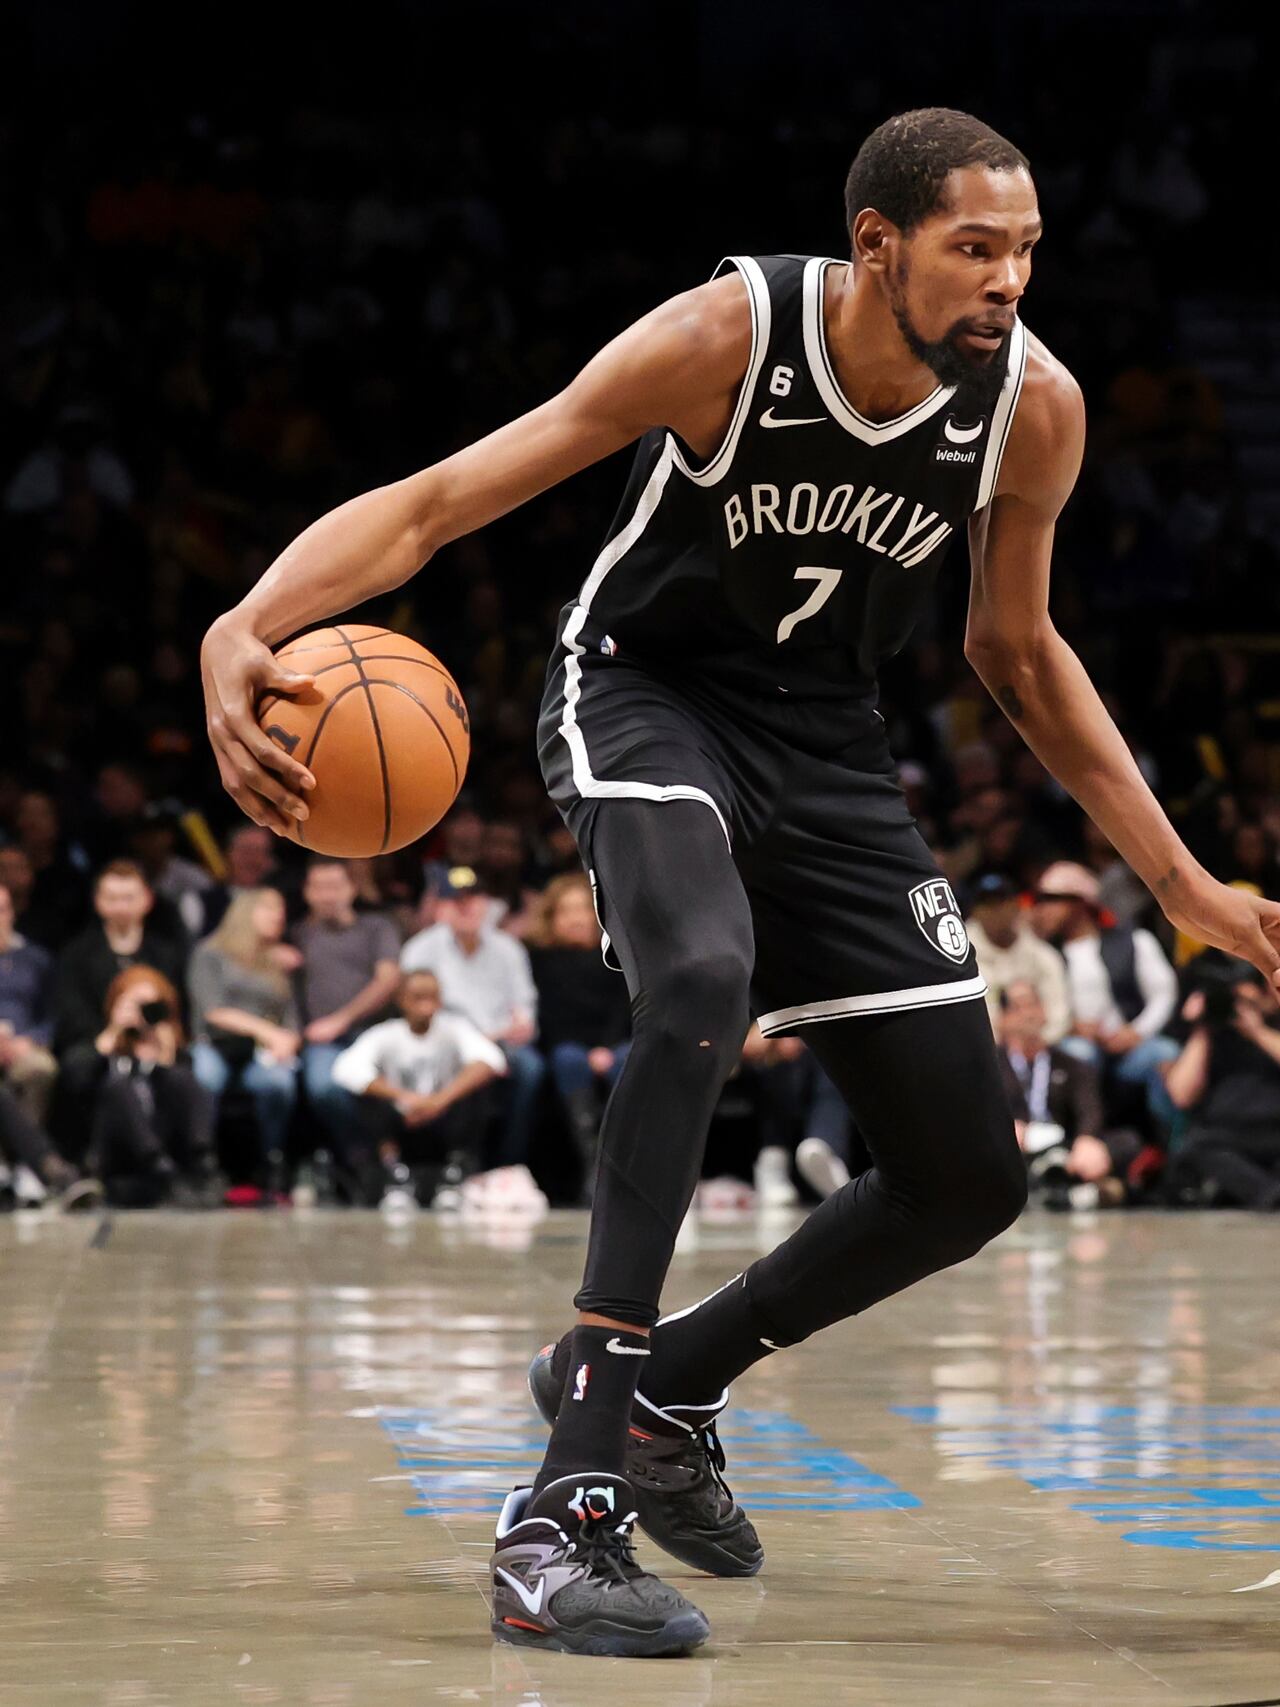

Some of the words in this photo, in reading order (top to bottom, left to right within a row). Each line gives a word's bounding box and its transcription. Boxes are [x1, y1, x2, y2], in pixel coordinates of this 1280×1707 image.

[769, 365, 795, 397] 6
[935, 449, 976, 464] Webull
[724, 482, 953, 569] BROOKLYN
[777, 566, 843, 644] 7
[914, 882, 961, 924] NET
